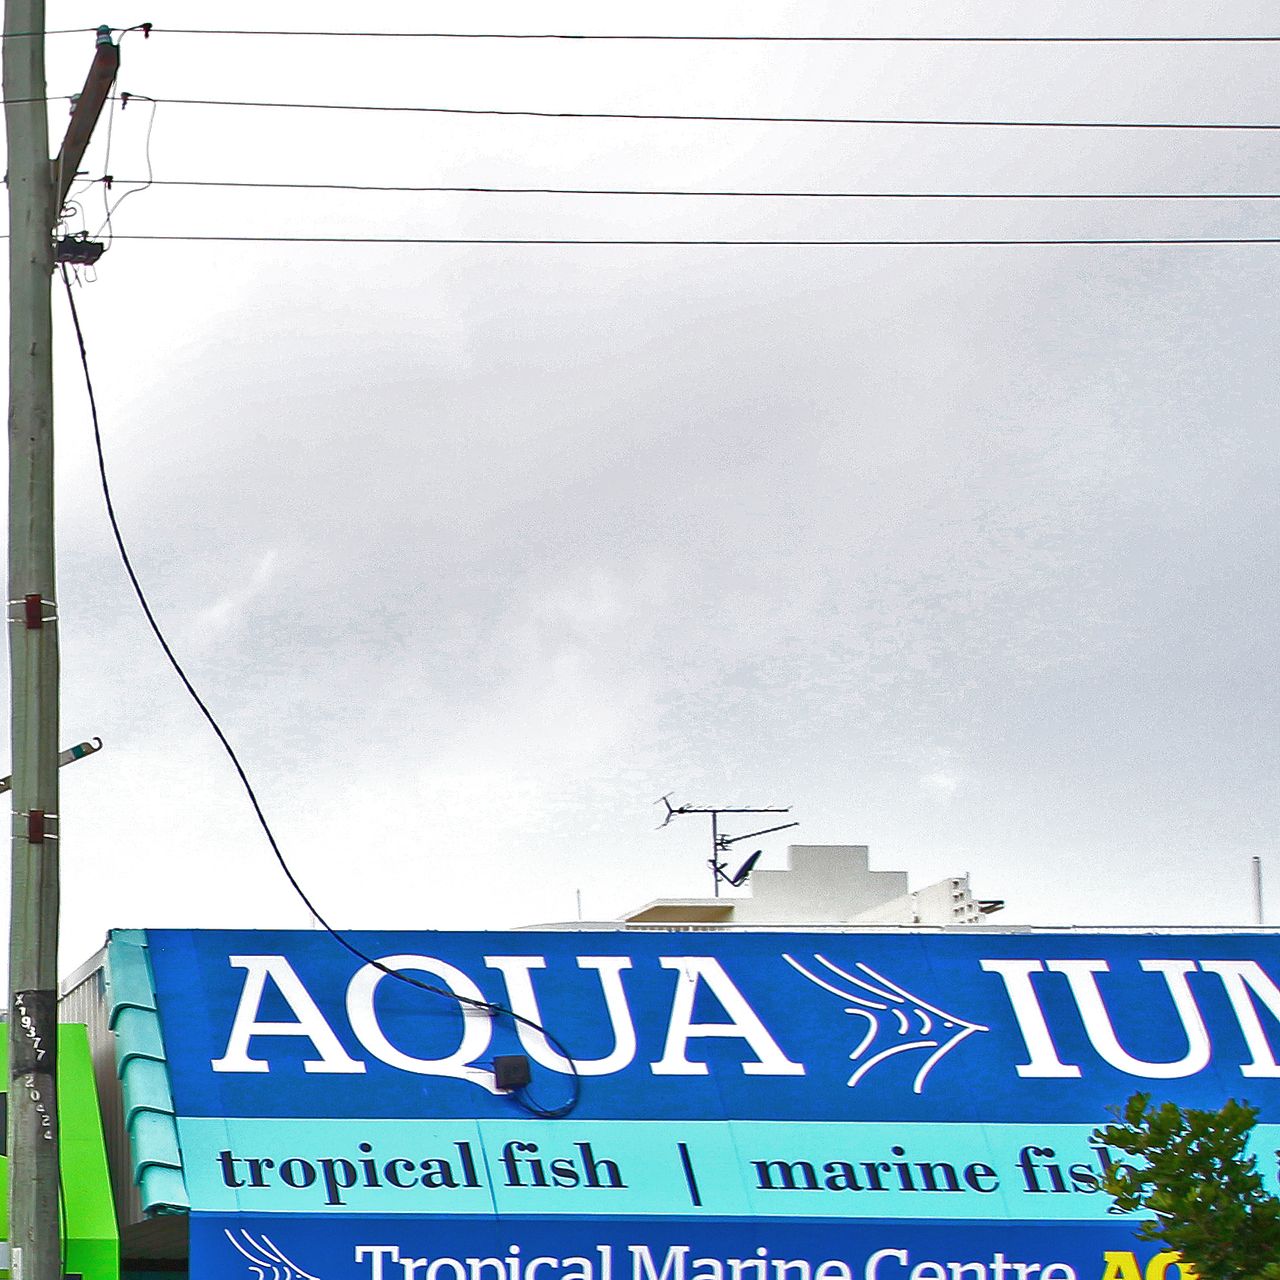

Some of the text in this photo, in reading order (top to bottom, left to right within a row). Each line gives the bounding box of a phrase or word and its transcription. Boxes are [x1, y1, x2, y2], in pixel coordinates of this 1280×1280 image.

[211, 954, 805, 1095] AQUA
[216, 1141, 628, 1205] tropical fish
[750, 1145, 1000, 1194] marine
